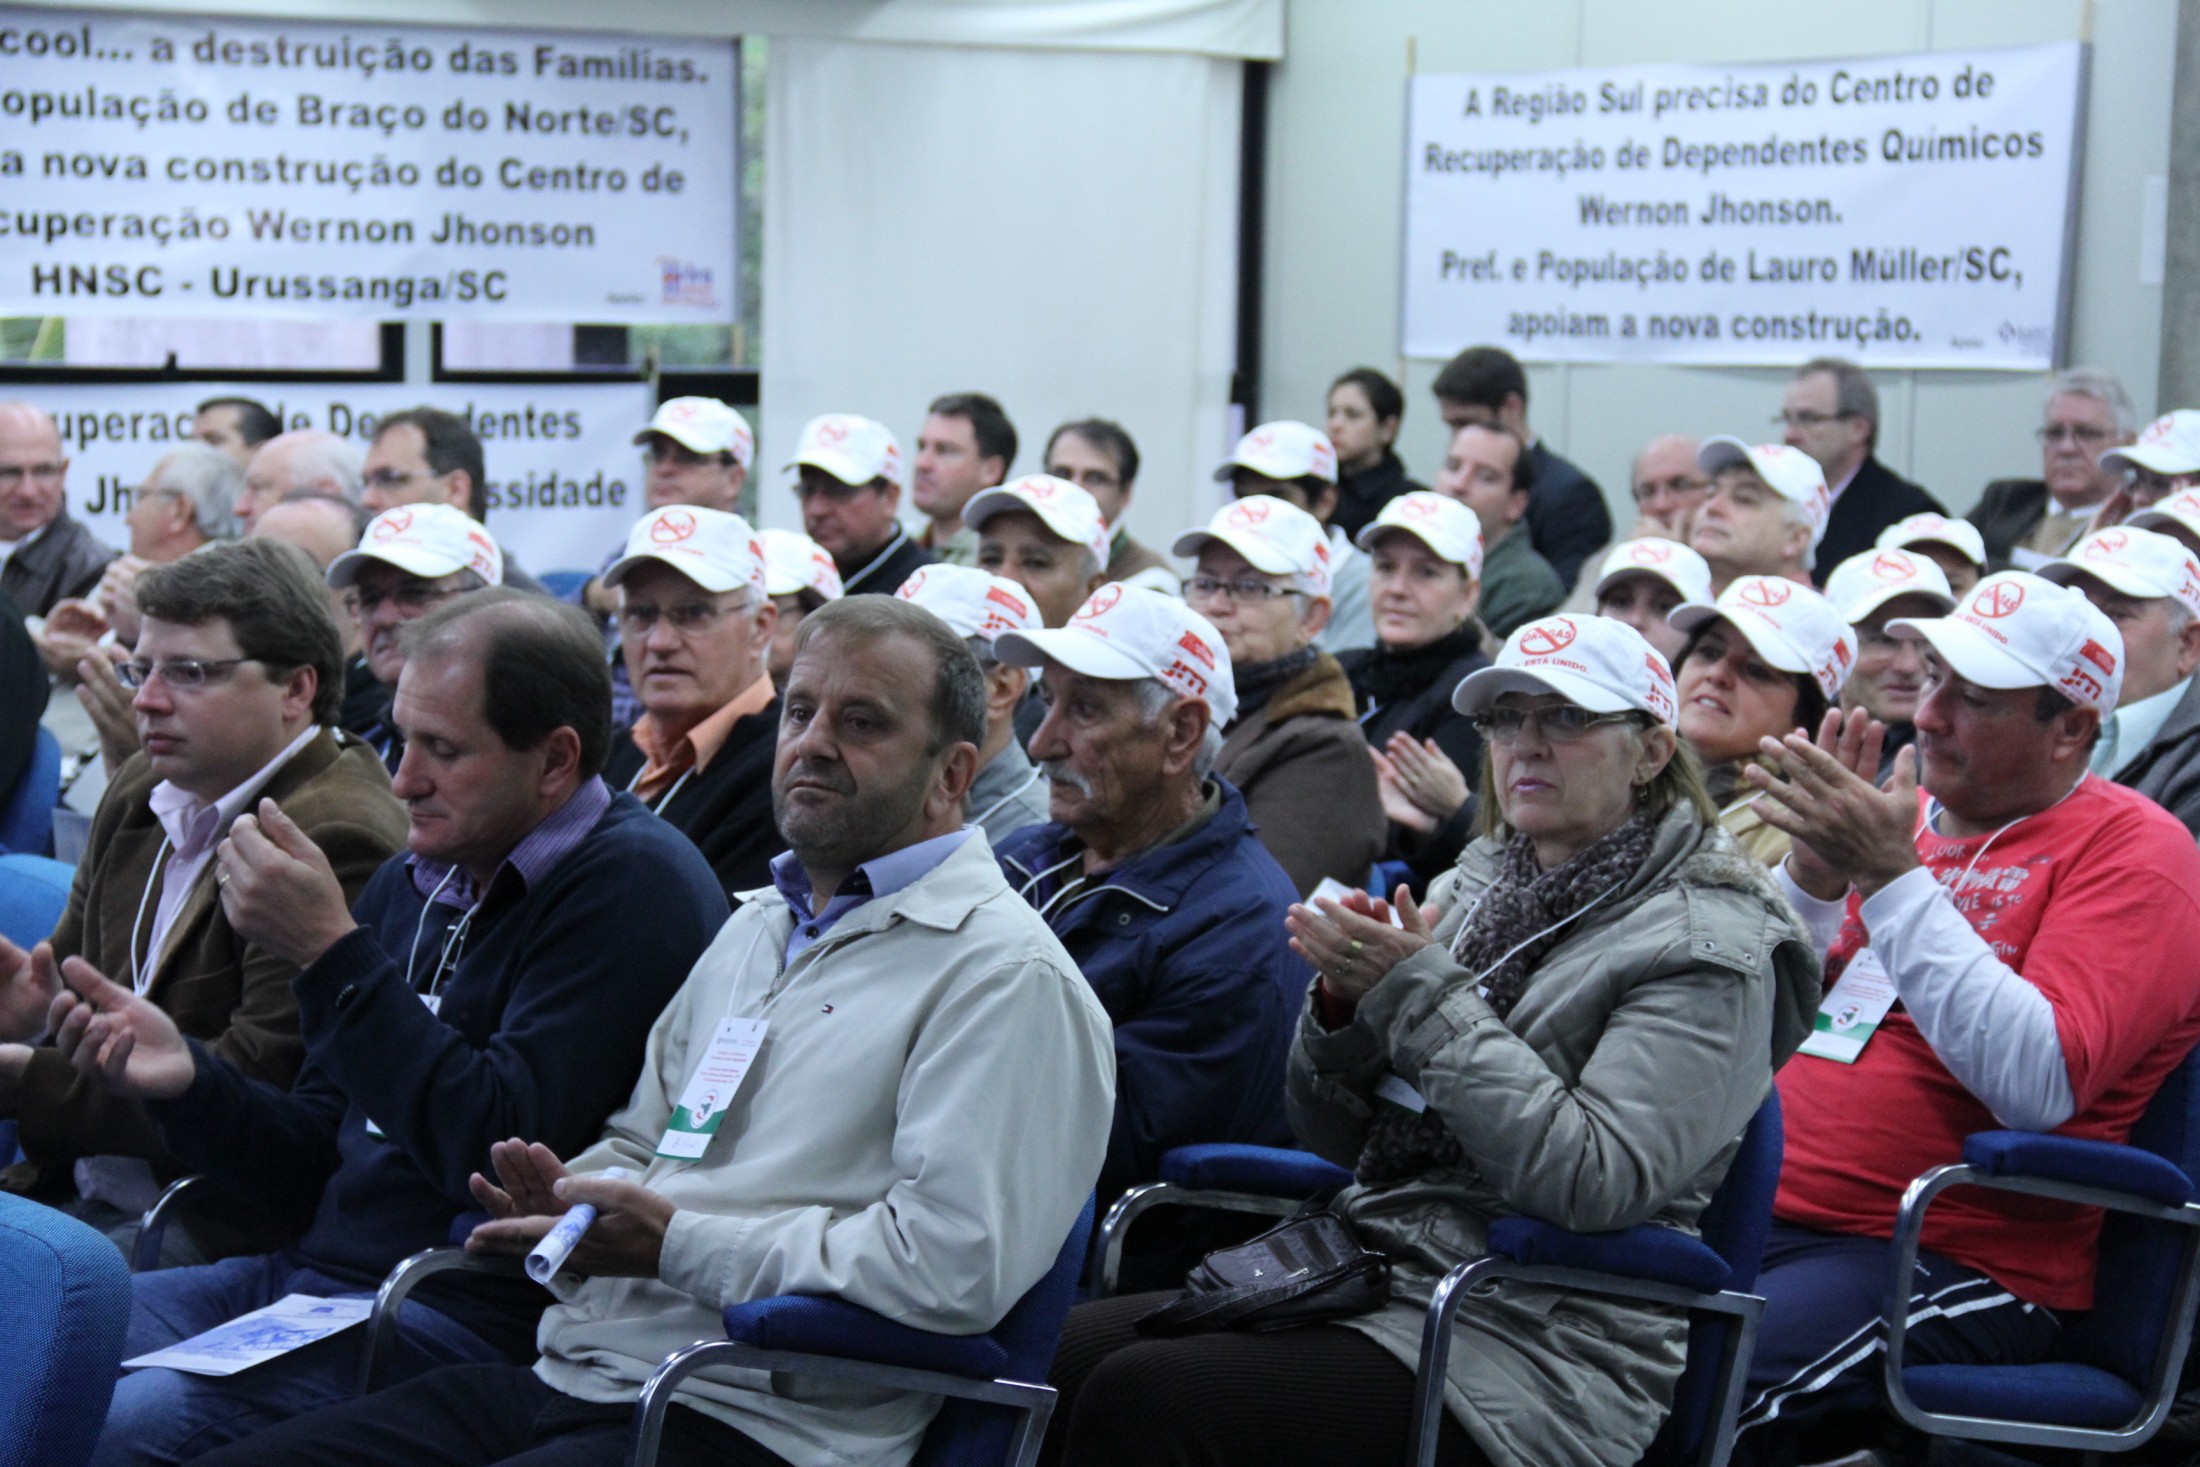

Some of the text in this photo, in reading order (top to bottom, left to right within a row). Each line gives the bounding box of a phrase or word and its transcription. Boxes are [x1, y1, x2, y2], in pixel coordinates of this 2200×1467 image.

[151, 34, 175, 63] a
[191, 30, 433, 79] destruição
[448, 41, 518, 76] das
[0, 86, 208, 129] opulação
[226, 92, 279, 126] de
[297, 94, 428, 137] Braço
[441, 99, 490, 132] do
[1463, 65, 1994, 126] A Região Sul precisa do Centro de
[43, 153, 148, 180] nova
[165, 154, 421, 194] construção
[435, 157, 484, 189] do
[498, 157, 628, 193] Centro
[641, 162, 685, 194] de
[1423, 140, 1606, 180] Recuperação
[1615, 139, 1651, 171] de
[1661, 135, 1868, 176] Dependentes
[247, 210, 415, 245] Wernon
[431, 213, 595, 248] Jhonson
[1578, 193, 1843, 227] Wernon Jhonson.
[32, 264, 163, 297] HNSC
[210, 267, 508, 310] Urussanga/SC
[1440, 249, 1502, 282] Pref.
[1510, 258, 1527, 282] e
[1536, 249, 1689, 291] População
[1698, 251, 1736, 284] de
[1747, 250, 1838, 284] Lauro
[1506, 304, 1922, 349] apoiam a nova construção.
